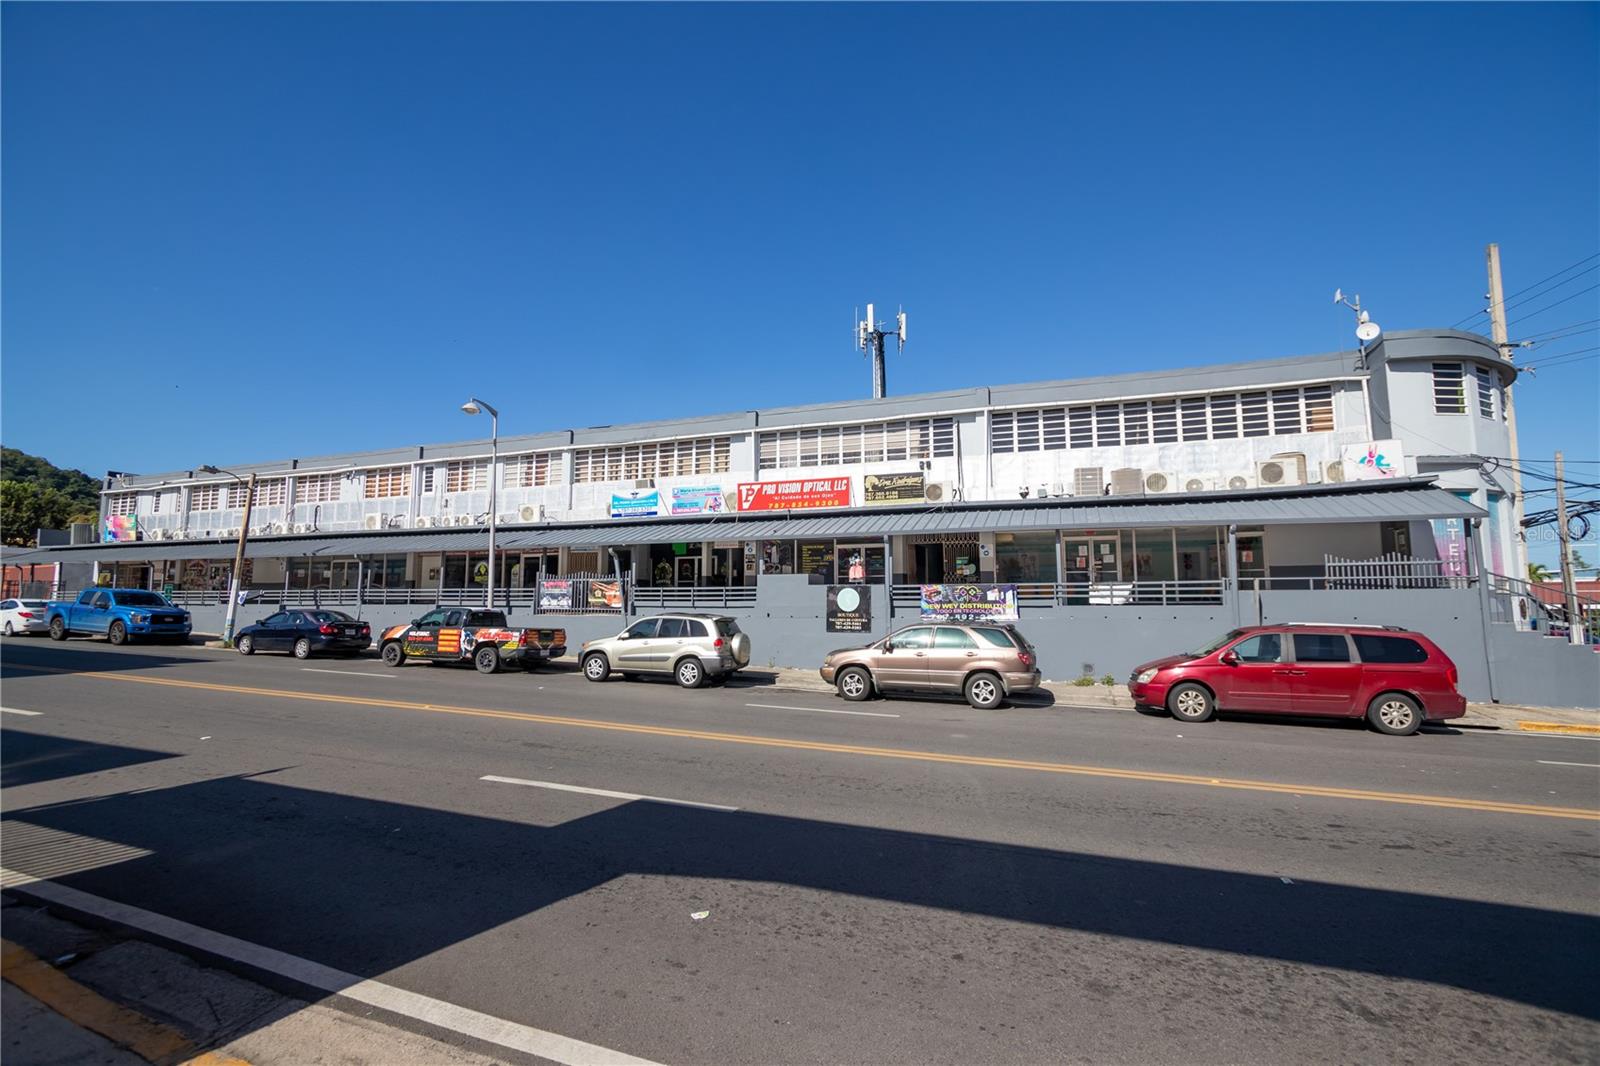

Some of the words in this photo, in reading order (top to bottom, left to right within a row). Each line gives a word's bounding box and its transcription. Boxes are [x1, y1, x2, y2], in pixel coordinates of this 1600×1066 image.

[762, 483, 776, 495] PRO
[778, 482, 801, 493] VISION
[803, 481, 832, 493] OPTICAL
[834, 479, 847, 491] LLC
